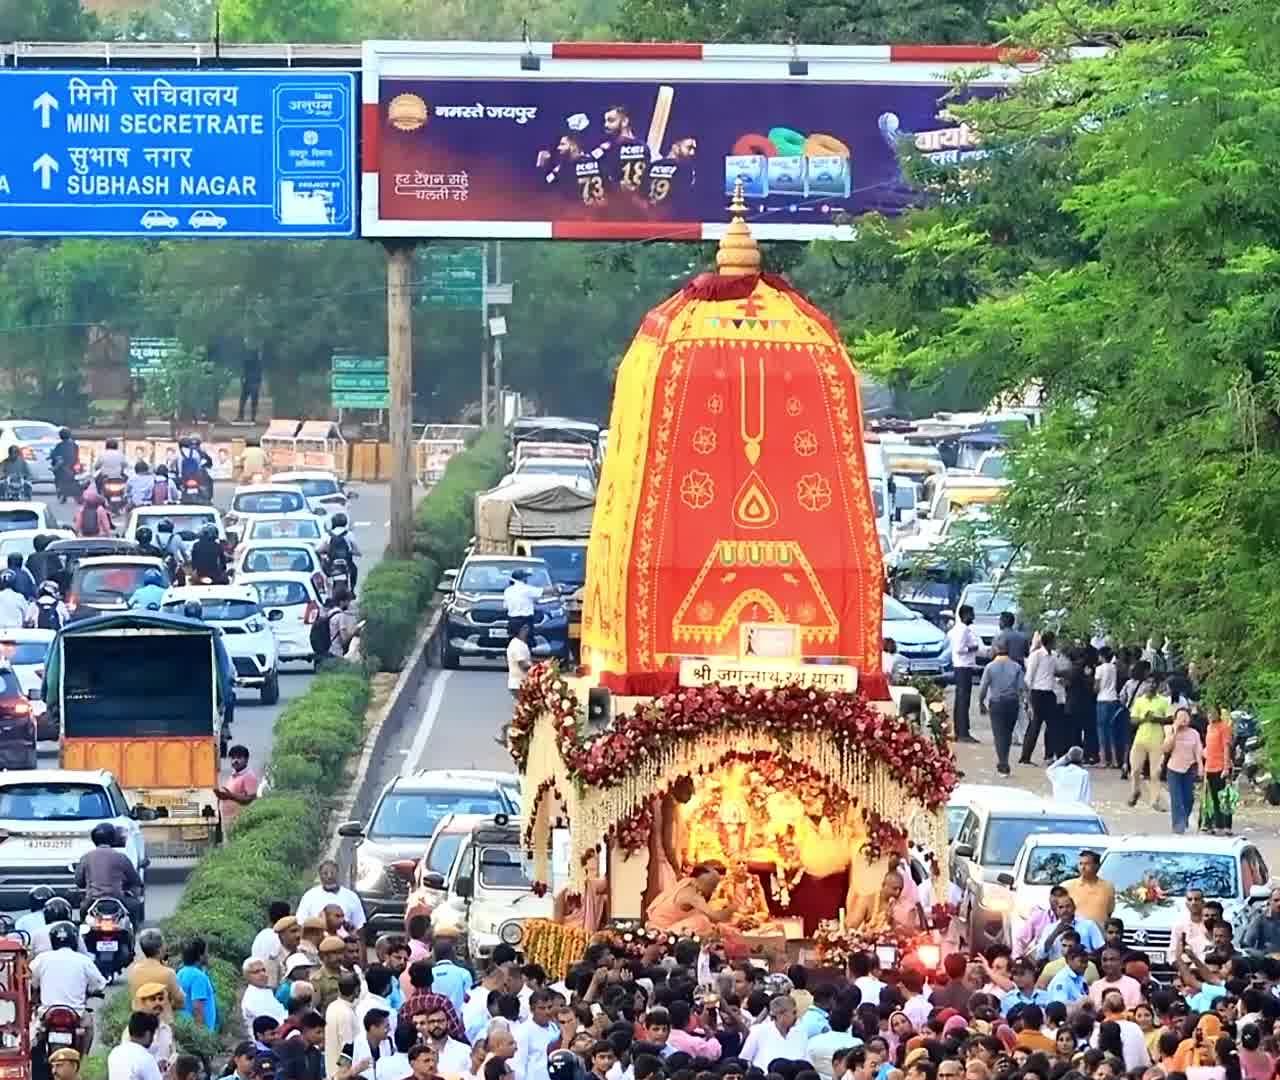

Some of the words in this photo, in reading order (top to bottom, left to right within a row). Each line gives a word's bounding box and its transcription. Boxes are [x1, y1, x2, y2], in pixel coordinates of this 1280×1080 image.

[68, 77, 118, 106] मिनी
[130, 78, 238, 106] सचिवालय
[67, 113, 109, 133] MINI
[120, 113, 264, 134] SECRETRATE
[435, 102, 484, 119] नमस्ते
[487, 107, 537, 124] जयपुर
[67, 147, 130, 174] सुभाष
[144, 148, 192, 168] नगर
[67, 175, 169, 195] SUBHASH
[180, 175, 257, 195] NAGAR
[578, 176, 604, 205] 73
[693, 664, 711, 681] श्री
